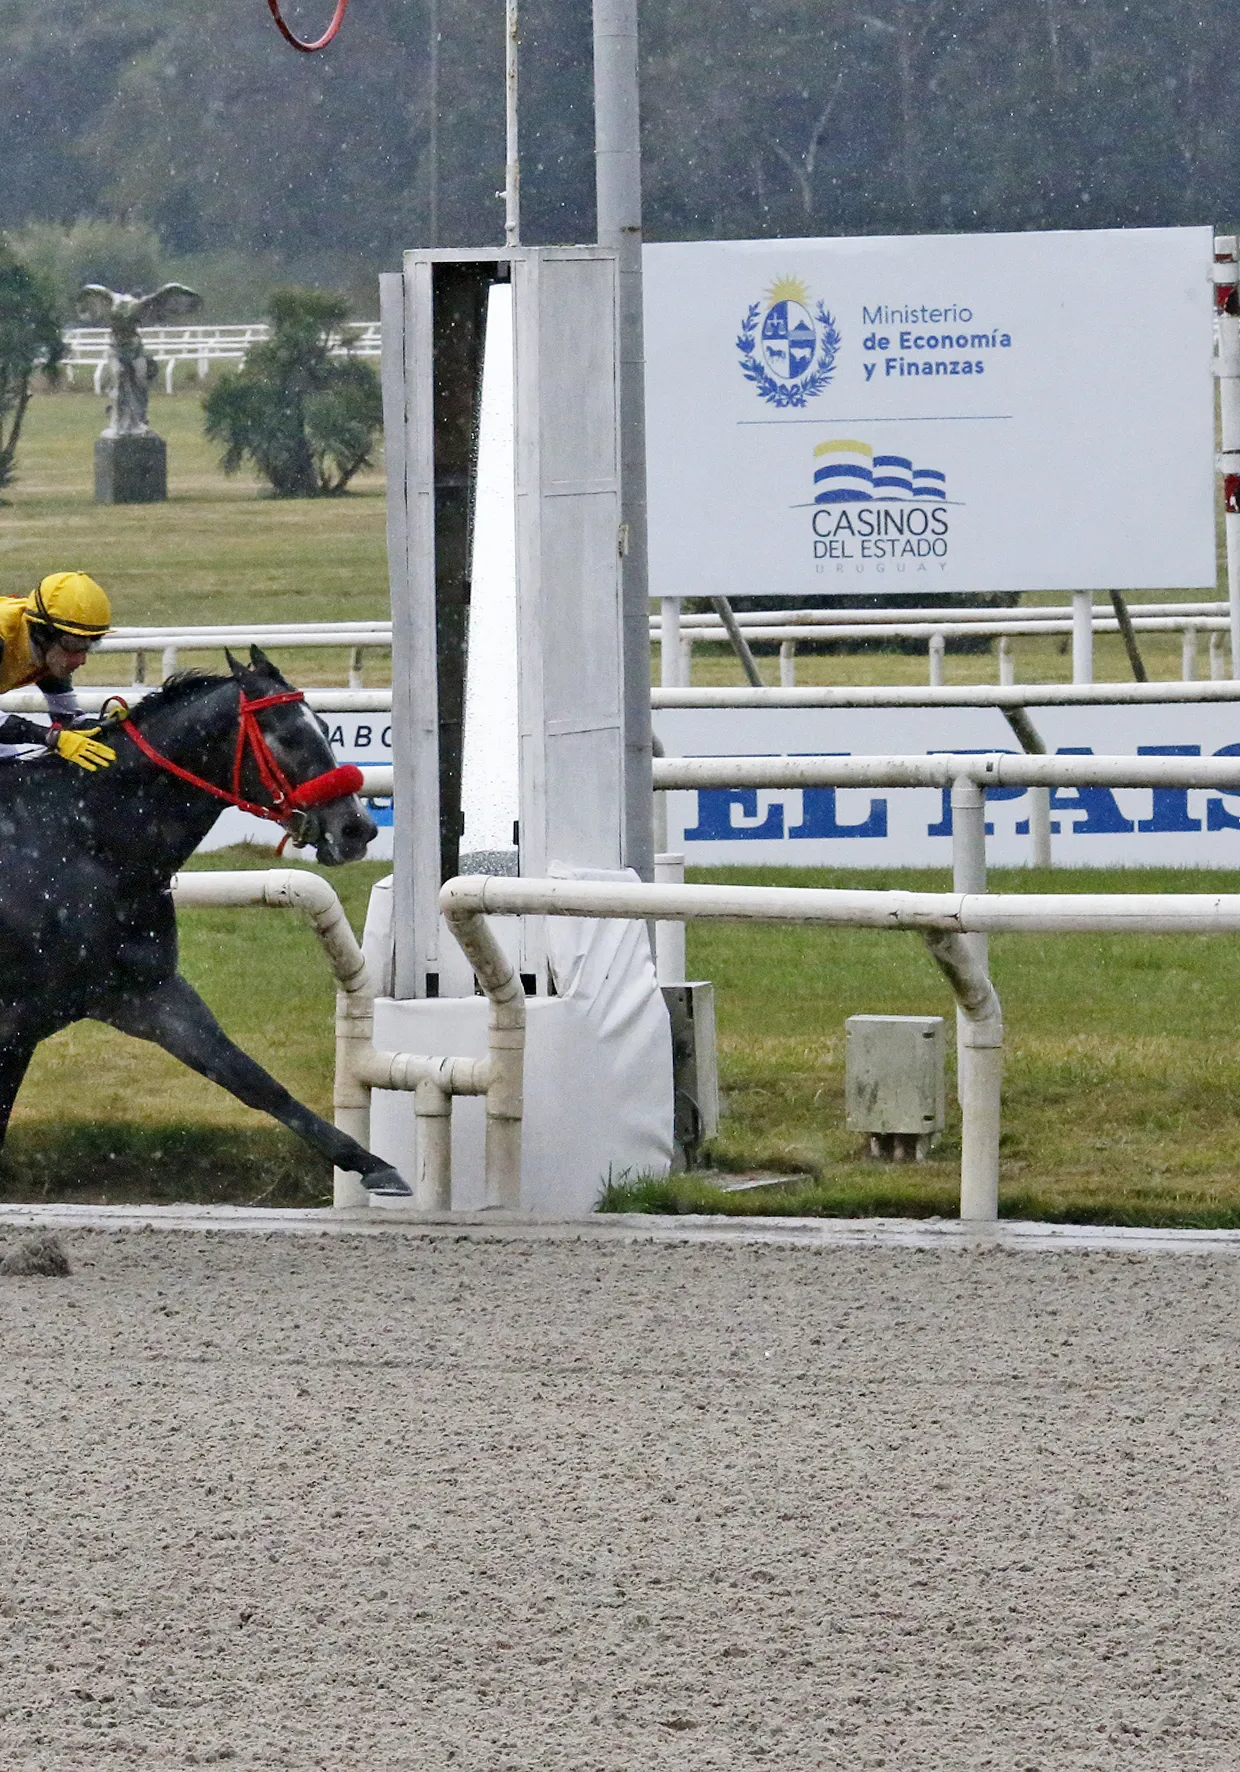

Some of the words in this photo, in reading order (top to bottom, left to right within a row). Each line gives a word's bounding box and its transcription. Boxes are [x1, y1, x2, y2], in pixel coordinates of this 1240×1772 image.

[861, 303, 973, 325] Ministerio
[862, 332, 891, 351] de
[899, 328, 1012, 350] Economía
[863, 362, 877, 381] y
[885, 357, 985, 377] Finanzas
[812, 507, 949, 538] CASINOS
[813, 539, 854, 559] DEL
[860, 537, 948, 559] ESTADO
[815, 561, 948, 574] URUGUAY
[682, 752, 888, 841] EL
